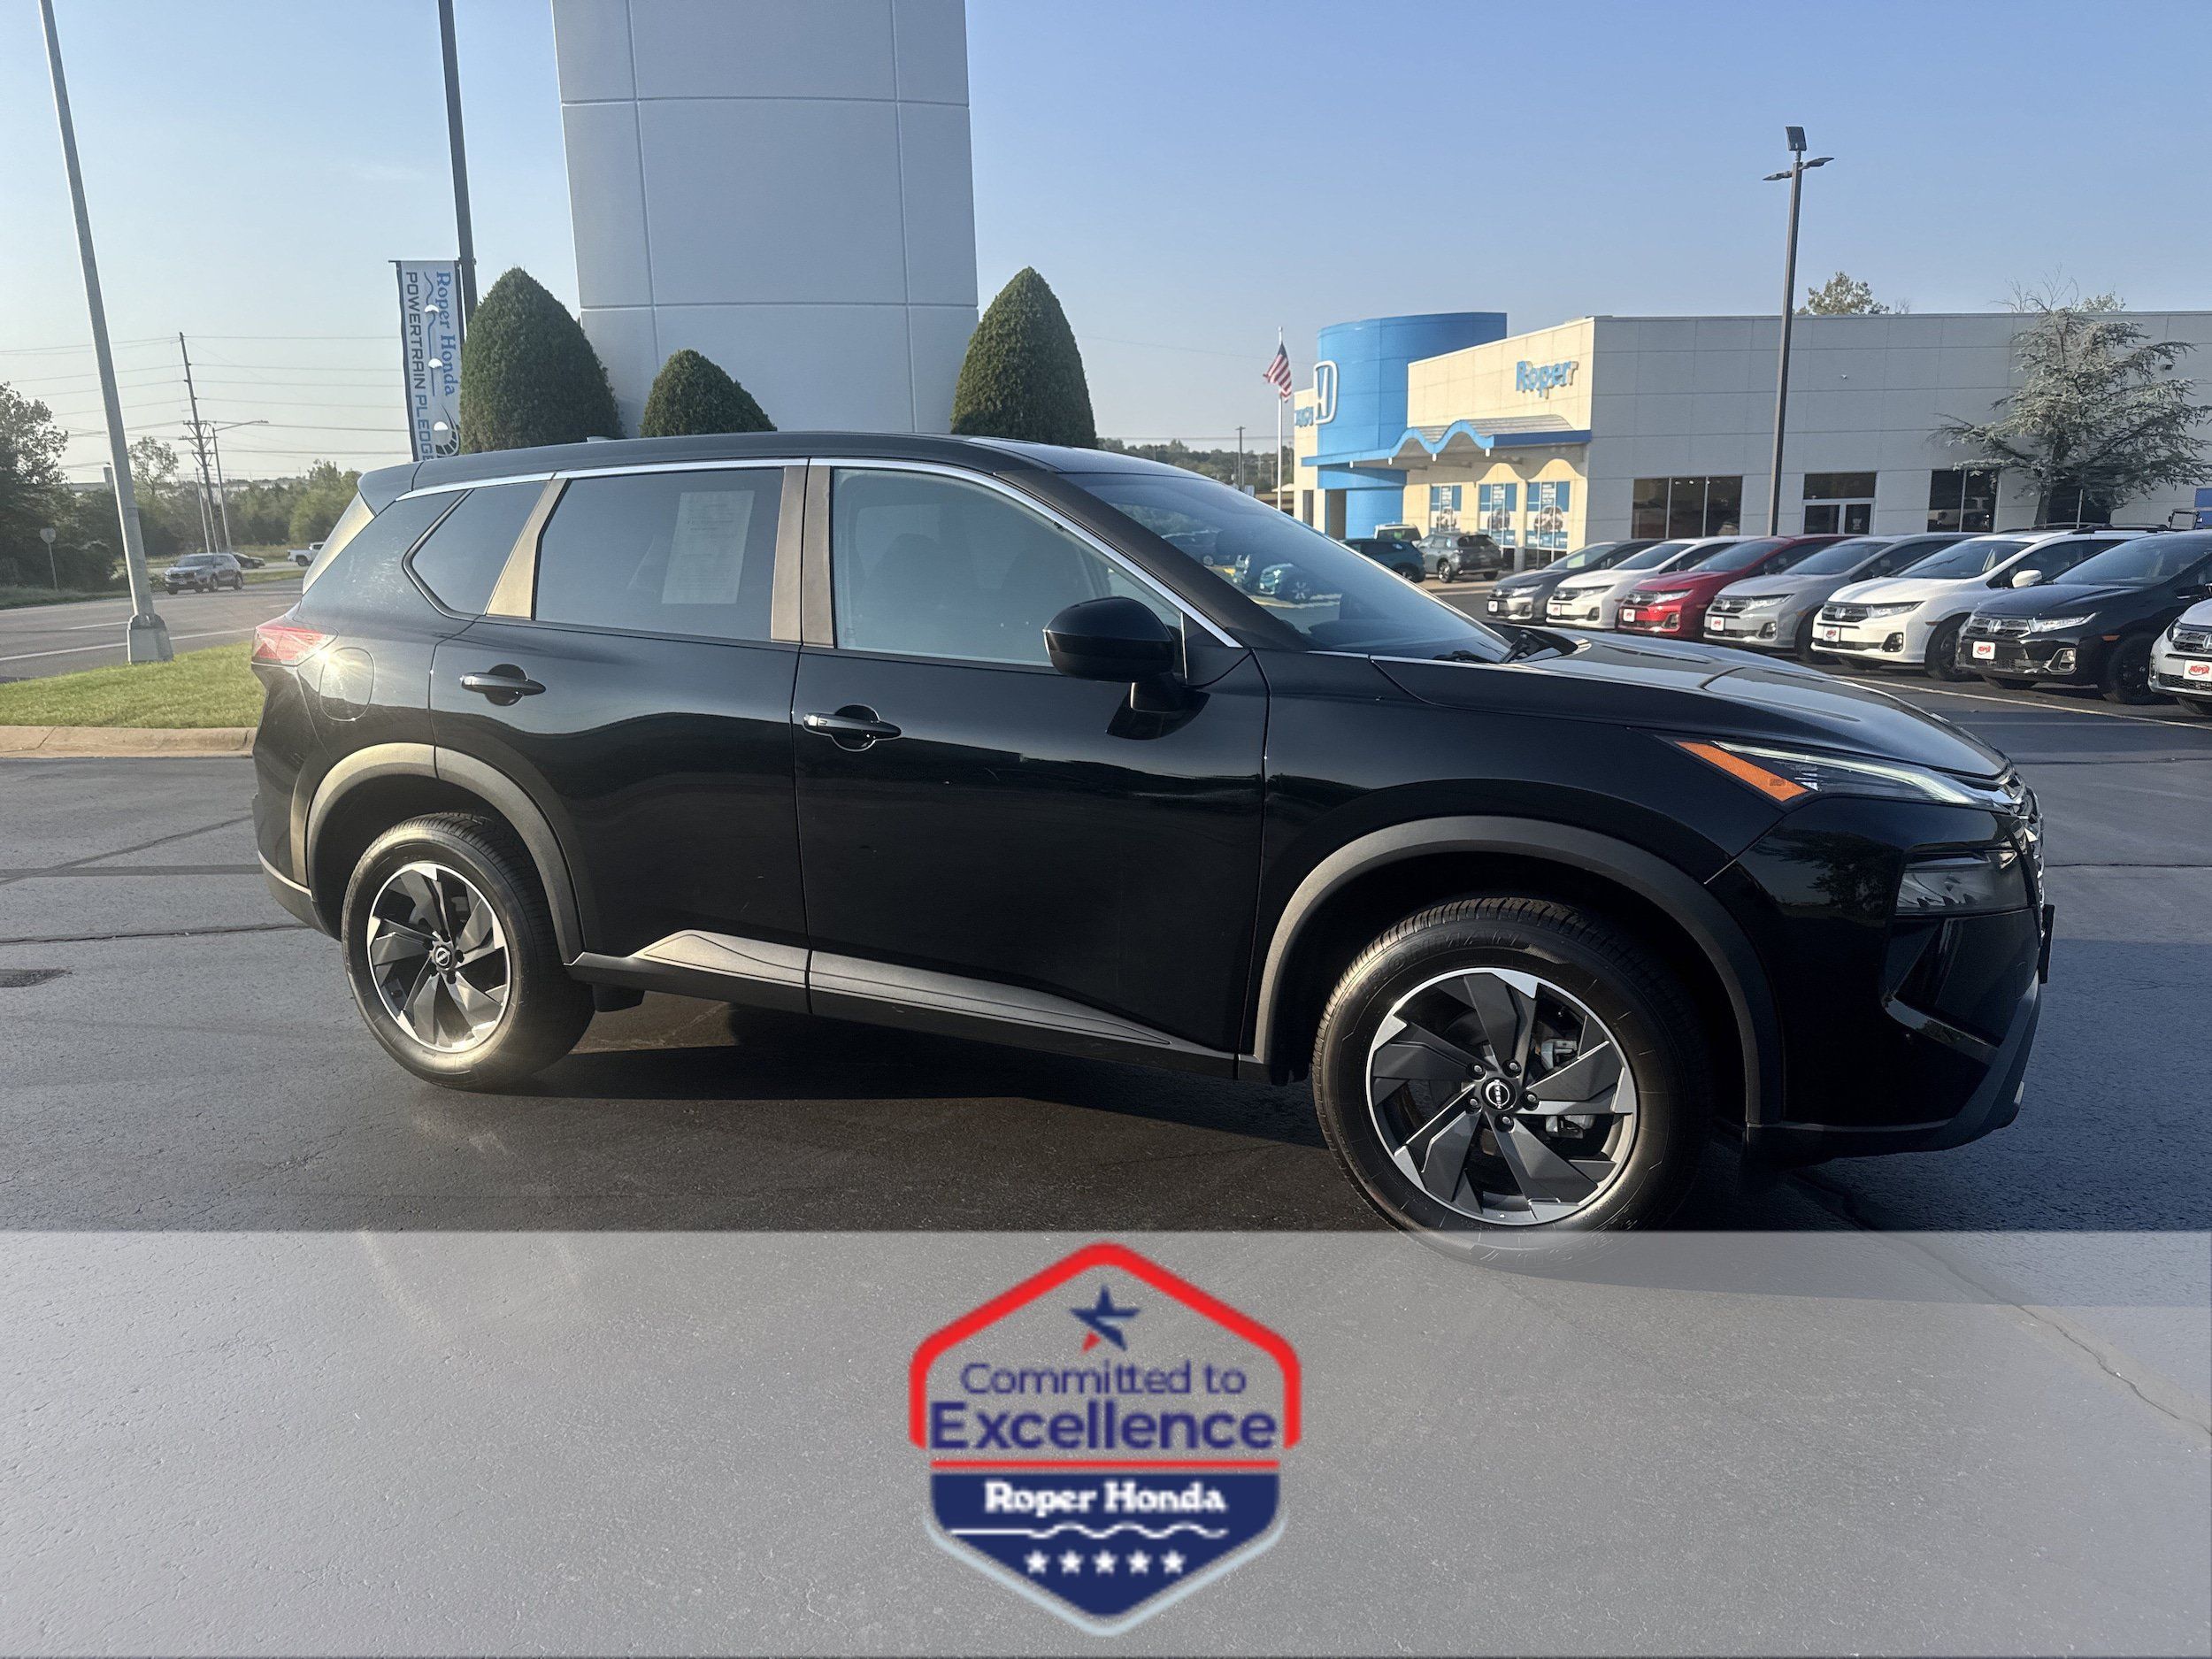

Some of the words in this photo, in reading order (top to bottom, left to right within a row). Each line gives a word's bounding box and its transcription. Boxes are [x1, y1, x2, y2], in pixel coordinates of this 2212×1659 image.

[435, 272, 451, 329] Roper
[406, 272, 426, 389] POWERTRAIN
[441, 334, 459, 396] Honda
[1516, 361, 1578, 399] Roper
